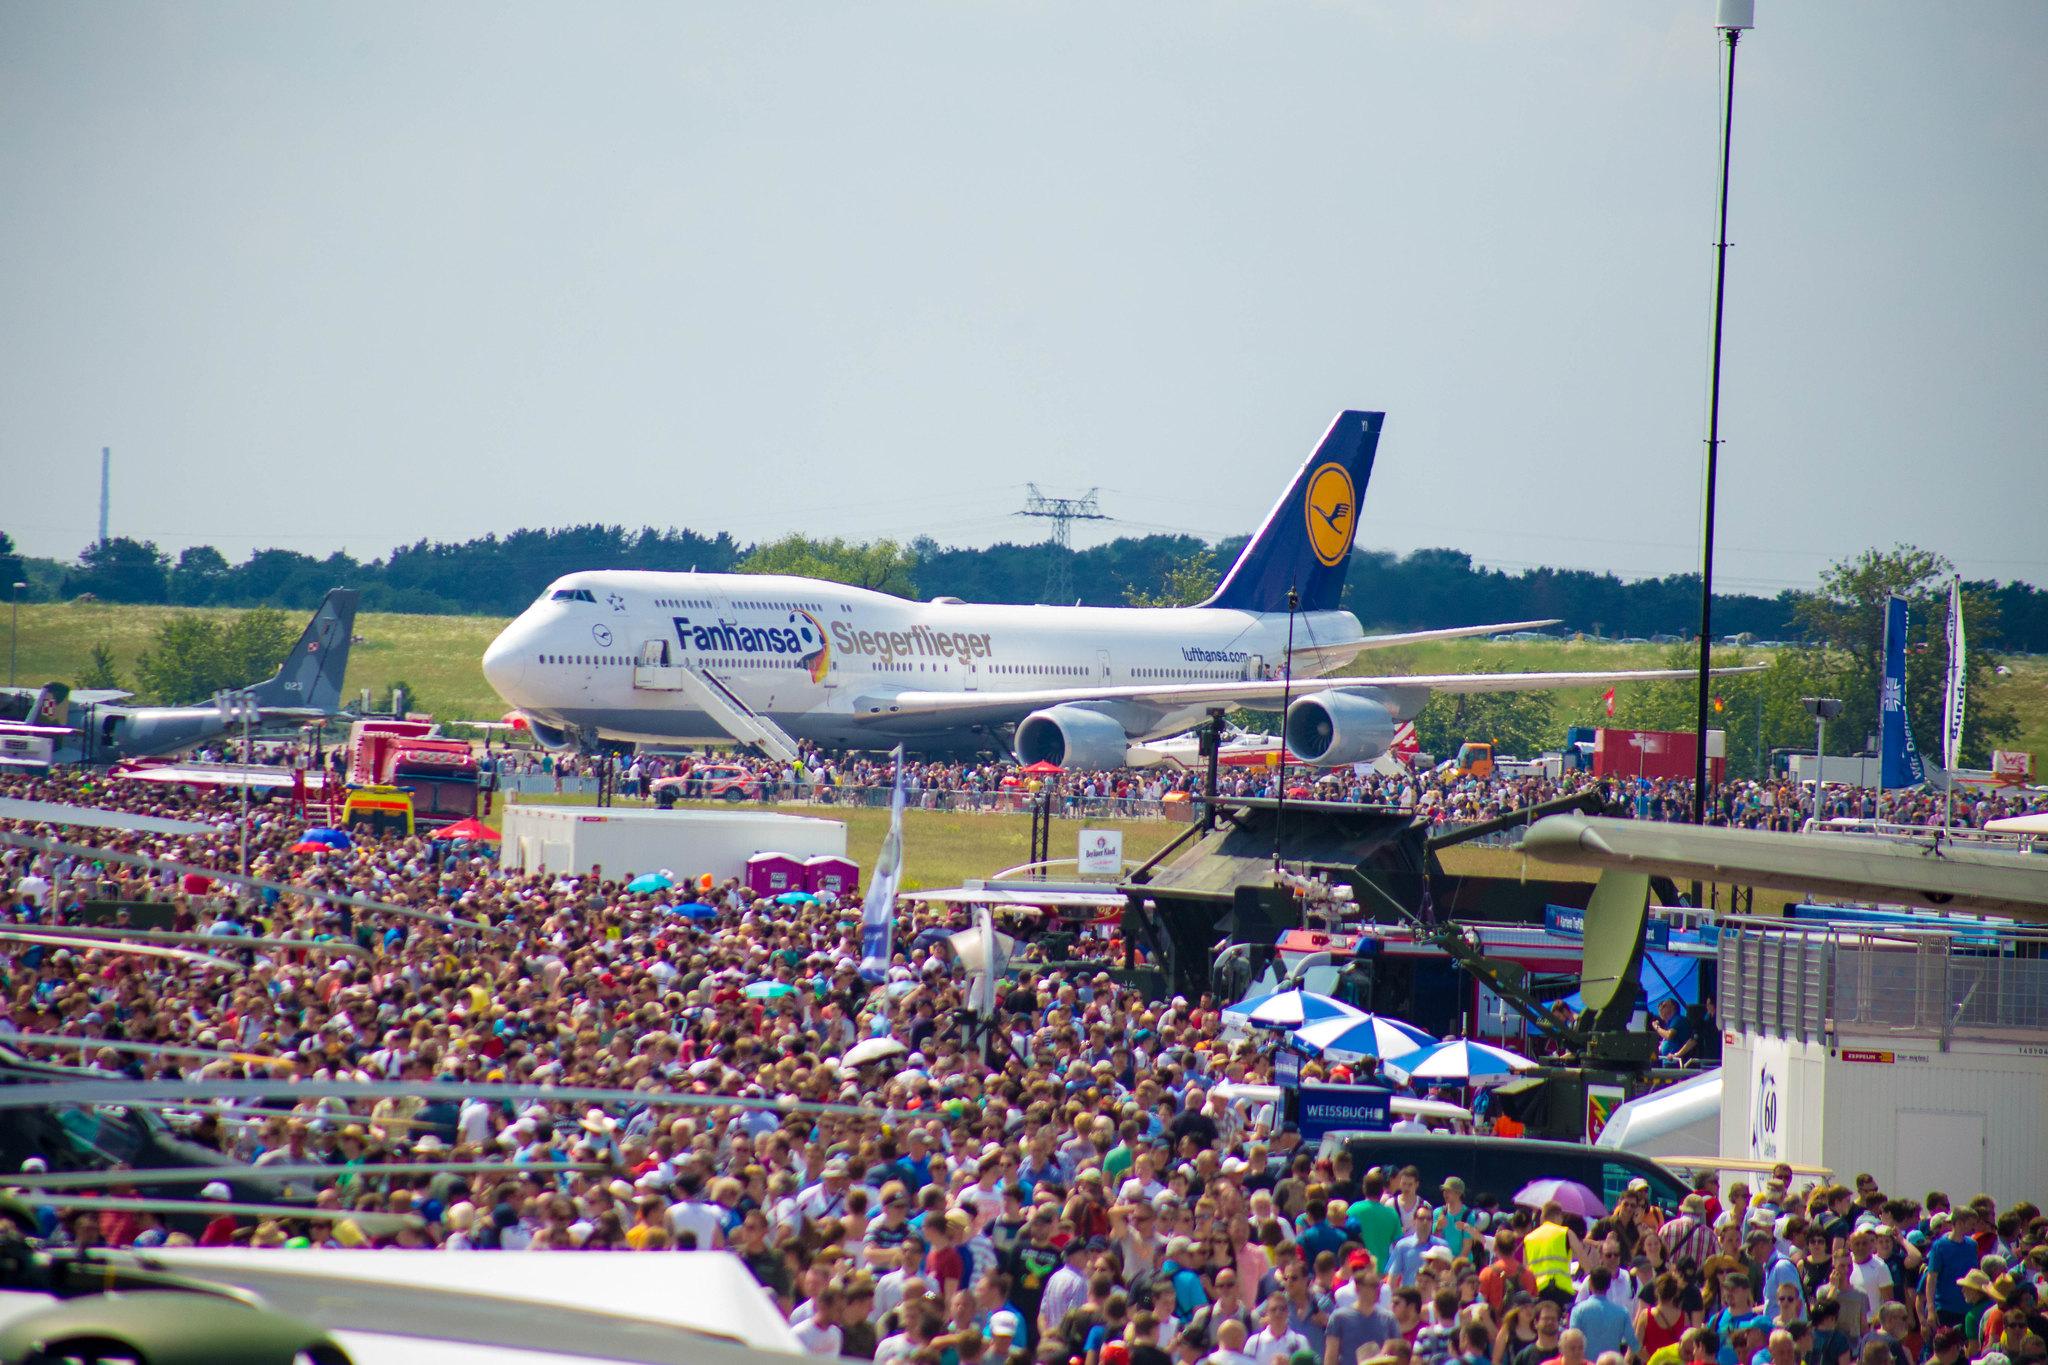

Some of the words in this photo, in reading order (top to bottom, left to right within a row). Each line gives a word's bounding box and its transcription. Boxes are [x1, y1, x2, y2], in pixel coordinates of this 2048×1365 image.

[672, 616, 803, 653] Fanhansa
[830, 620, 993, 666] Siegerflieger
[1181, 646, 1249, 663] lufthansa.com
[2003, 754, 2026, 765] WC
[1306, 1104, 1374, 1119] WEISSBUCH
[1764, 1091, 1777, 1134] 60
